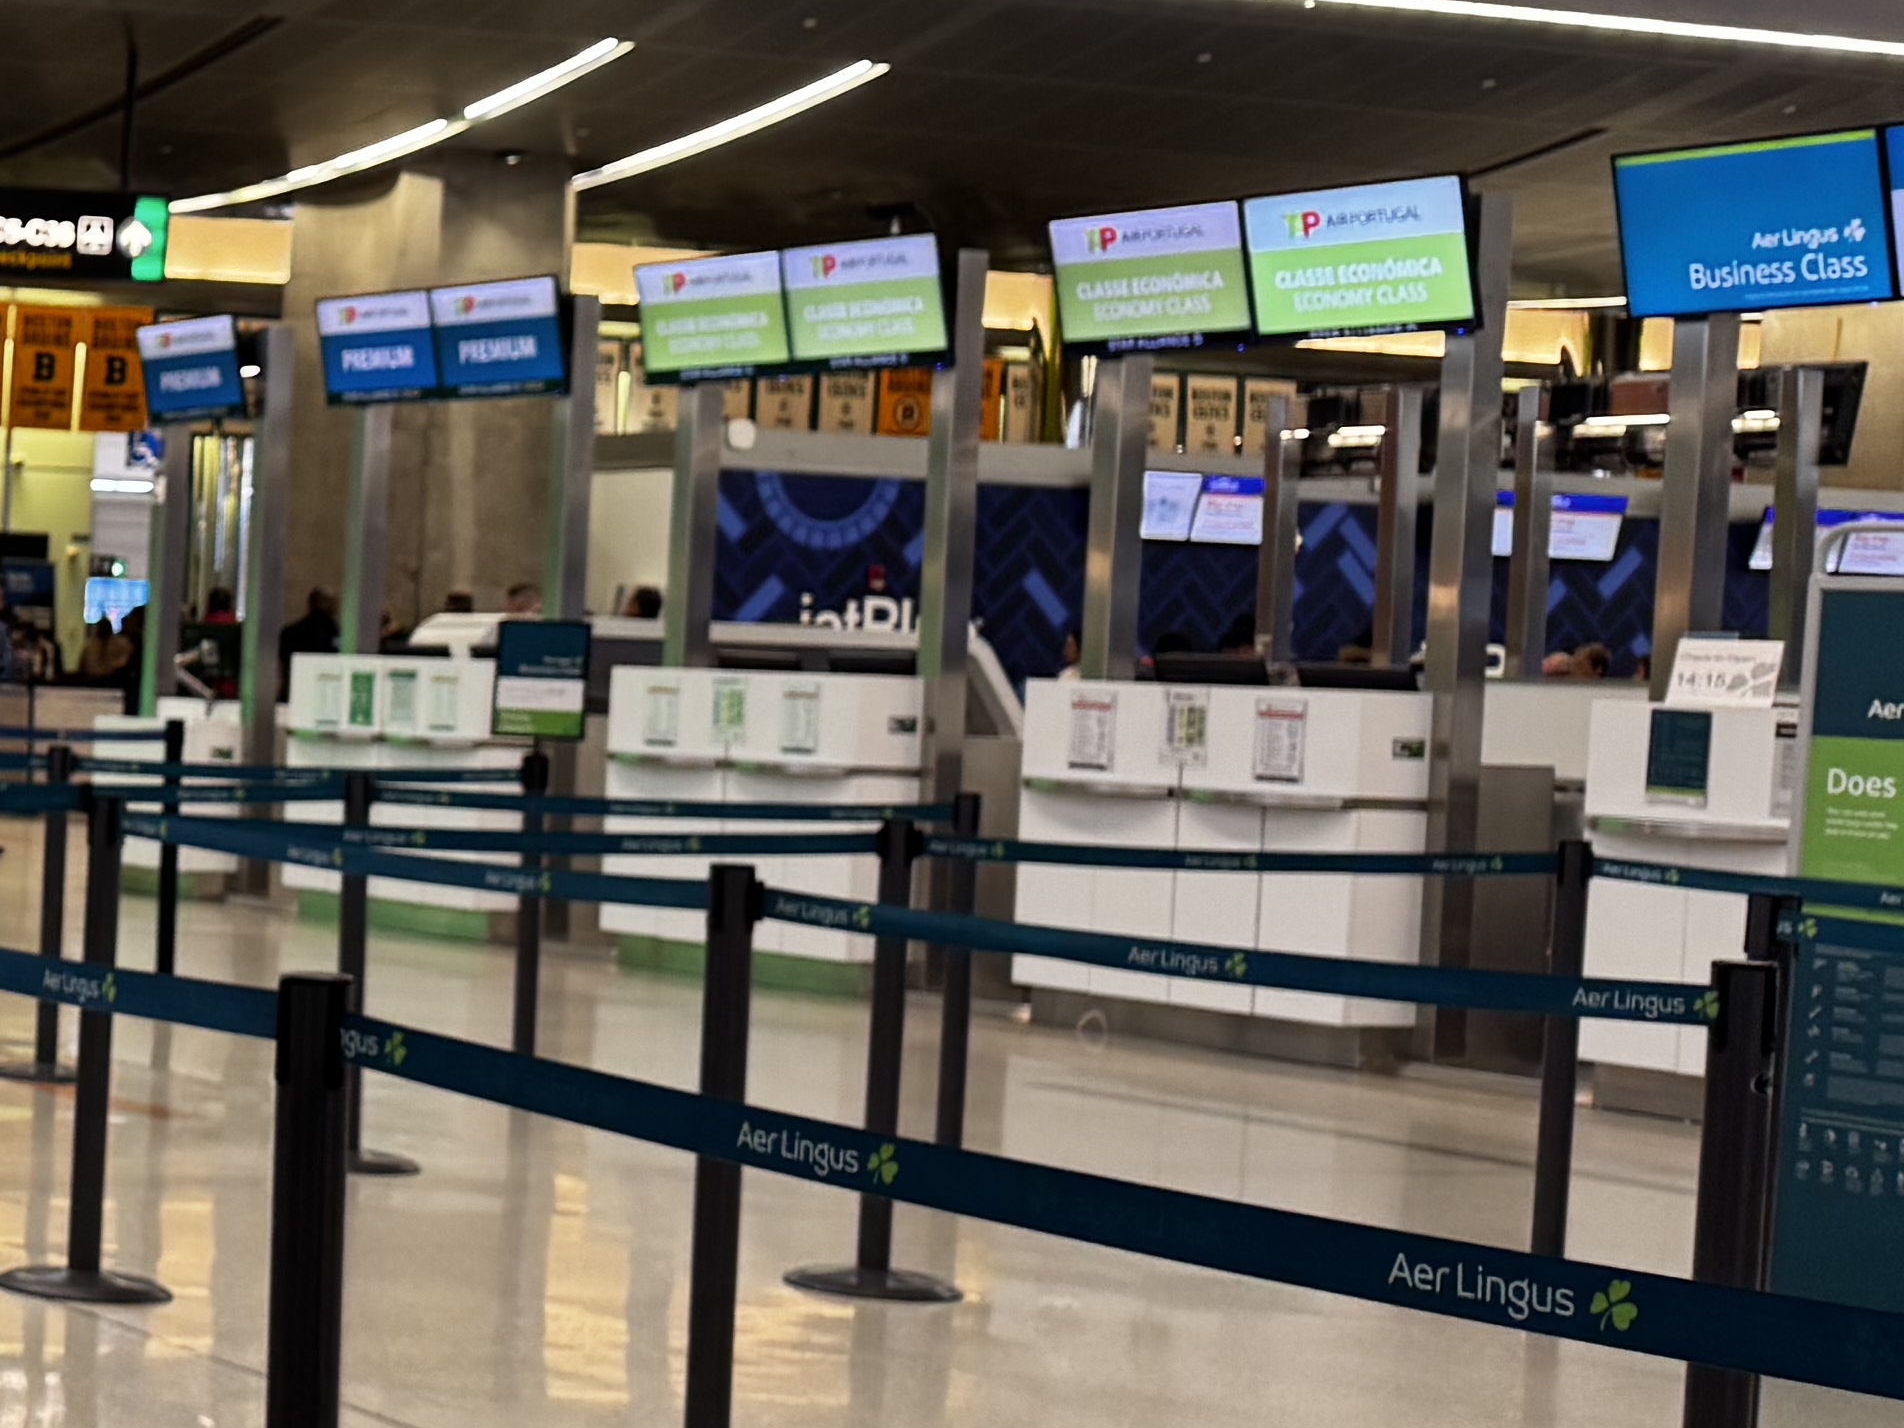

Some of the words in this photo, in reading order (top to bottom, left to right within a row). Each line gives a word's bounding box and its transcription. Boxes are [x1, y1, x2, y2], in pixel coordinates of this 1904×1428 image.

[1752, 231, 1781, 250] Aer
[1782, 226, 1839, 249] Lingus
[1689, 260, 1796, 290] Business
[1801, 253, 1869, 282] Class
[1376, 281, 1429, 304] CLASS
[341, 344, 415, 373] PREMIUM
[458, 334, 539, 365] PREMIUM
[34, 352, 56, 382] B
[105, 355, 128, 386] B
[1826, 766, 1898, 800] Does
[1127, 946, 1159, 965] Aer
[1161, 948, 1219, 976] Lingus
[1572, 987, 1613, 1009] Aer
[1614, 988, 1686, 1019] Lingus
[737, 1121, 778, 1154] Aer
[780, 1129, 860, 1177] Lingus
[1387, 1252, 1451, 1294] Aer
[1456, 1262, 1576, 1321] Lingus
